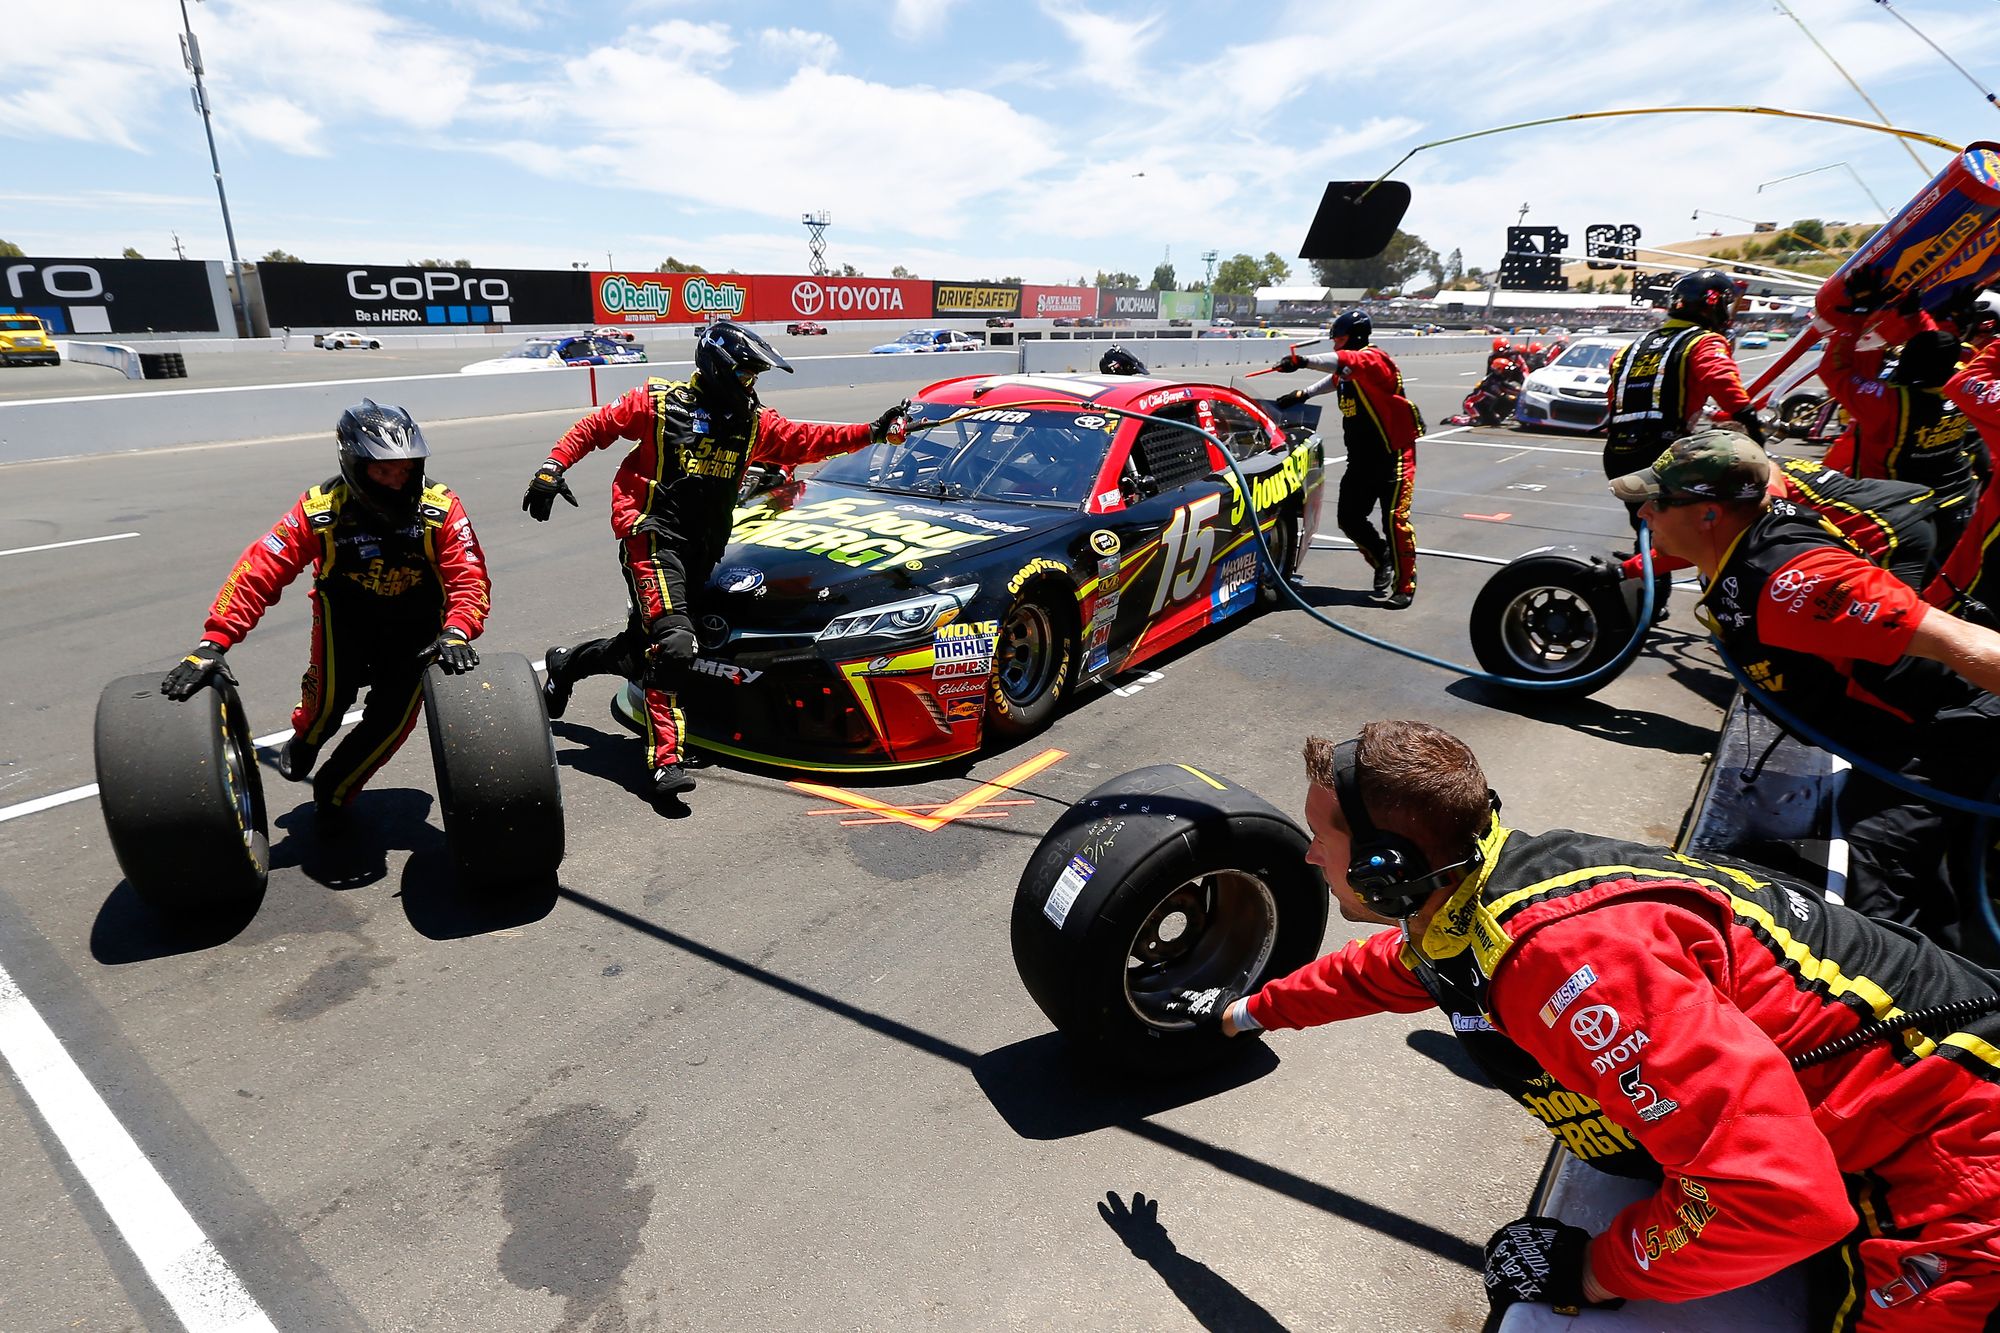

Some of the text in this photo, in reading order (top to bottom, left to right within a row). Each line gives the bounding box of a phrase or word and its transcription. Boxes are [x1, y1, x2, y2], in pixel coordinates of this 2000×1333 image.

[346, 270, 510, 301] GoPro
[602, 276, 670, 314] O'Reilly
[684, 276, 744, 313] O'Reilly
[825, 286, 904, 310] TOYOTA
[939, 289, 1018, 307] DRIVE SAFETY
[1060, 296, 1082, 305] MART
[1115, 296, 1157, 313] YOKOHAMA
[355, 309, 422, 322] Be a HERO.
[950, 408, 1031, 424] BWYER
[687, 458, 736, 479] ENERGY
[1224, 470, 1288, 526] 5hour
[775, 497, 999, 549] 5-hour
[949, 513, 1031, 533] Tasting
[1148, 492, 1222, 617] 15
[1221, 551, 1257, 580] MAXWELL
[1007, 556, 1068, 595] GOODYEAR
[1230, 566, 1257, 594] HOUSE
[936, 620, 998, 640] MOOG
[1092, 623, 1112, 649] 3M
[934, 638, 994, 659] MAHLE
[692, 657, 763, 684] MRY
[935, 660, 979, 676] COMP
[1052, 638, 1071, 701] EAGLE
[938, 679, 988, 696] Edelbrock
[950, 703, 983, 715] SUNOCO
[1458, 893, 1479, 937] ENERG
[1474, 917, 1495, 952] NERGY
[1551, 969, 1592, 1010] NASCAR
[1452, 1011, 1497, 1032] Aaro
